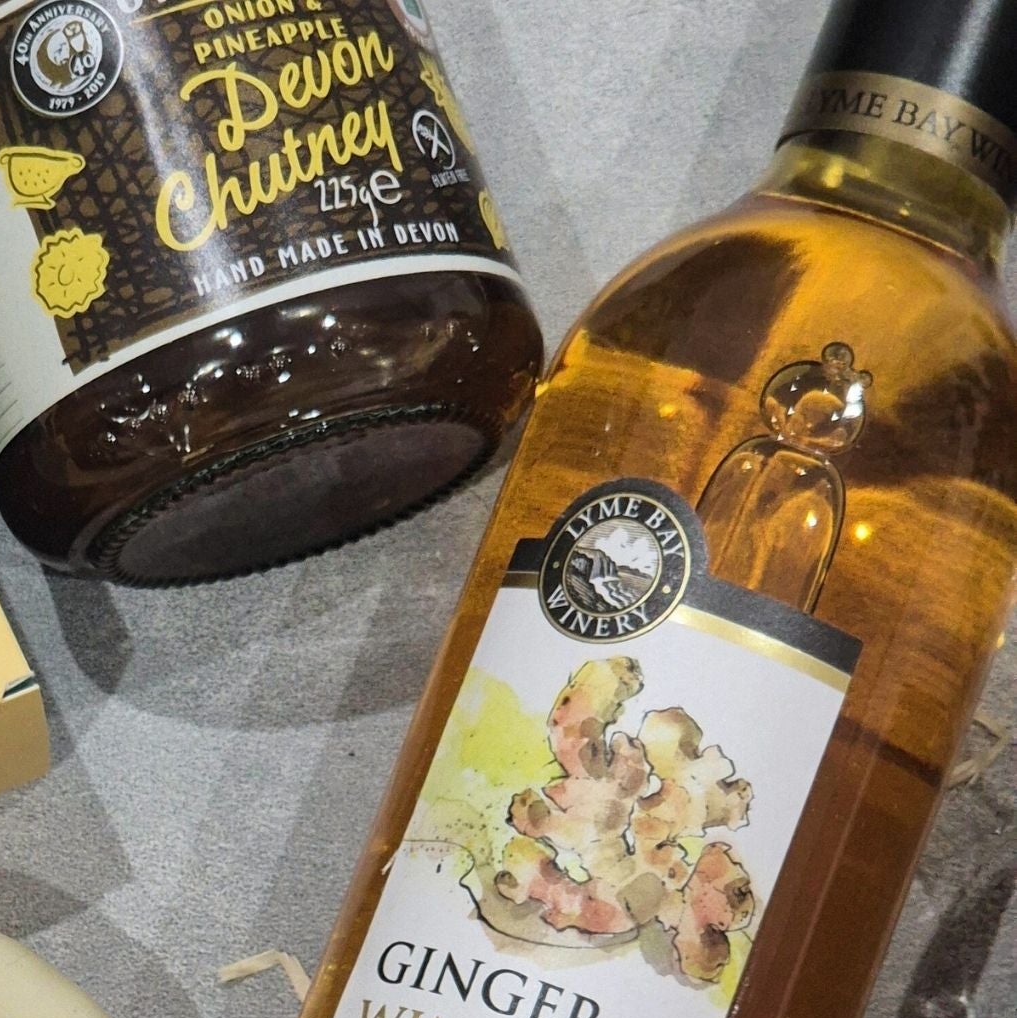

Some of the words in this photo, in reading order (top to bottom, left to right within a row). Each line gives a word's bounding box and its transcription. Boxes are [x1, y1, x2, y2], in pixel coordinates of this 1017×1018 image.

[28, 4, 112, 34] ANNIVERSARY
[204, 0, 295, 29] ONION
[72, 53, 96, 77] 40
[194, 18, 349, 65] PINEAPPLE
[49, 96, 75, 111] 1979
[83, 72, 107, 100] 2019
[180, 31, 394, 152] Devon
[892, 99, 967, 143] BAY
[155, 100, 404, 252] Chutney
[191, 254, 265, 298] HAND
[277, 233, 349, 269] MADE
[356, 227, 385, 251] IN
[393, 222, 460, 245] DEVON
[565, 497, 643, 541] LYME
[645, 507, 685, 558] BAY
[547, 584, 652, 637] WINERY
